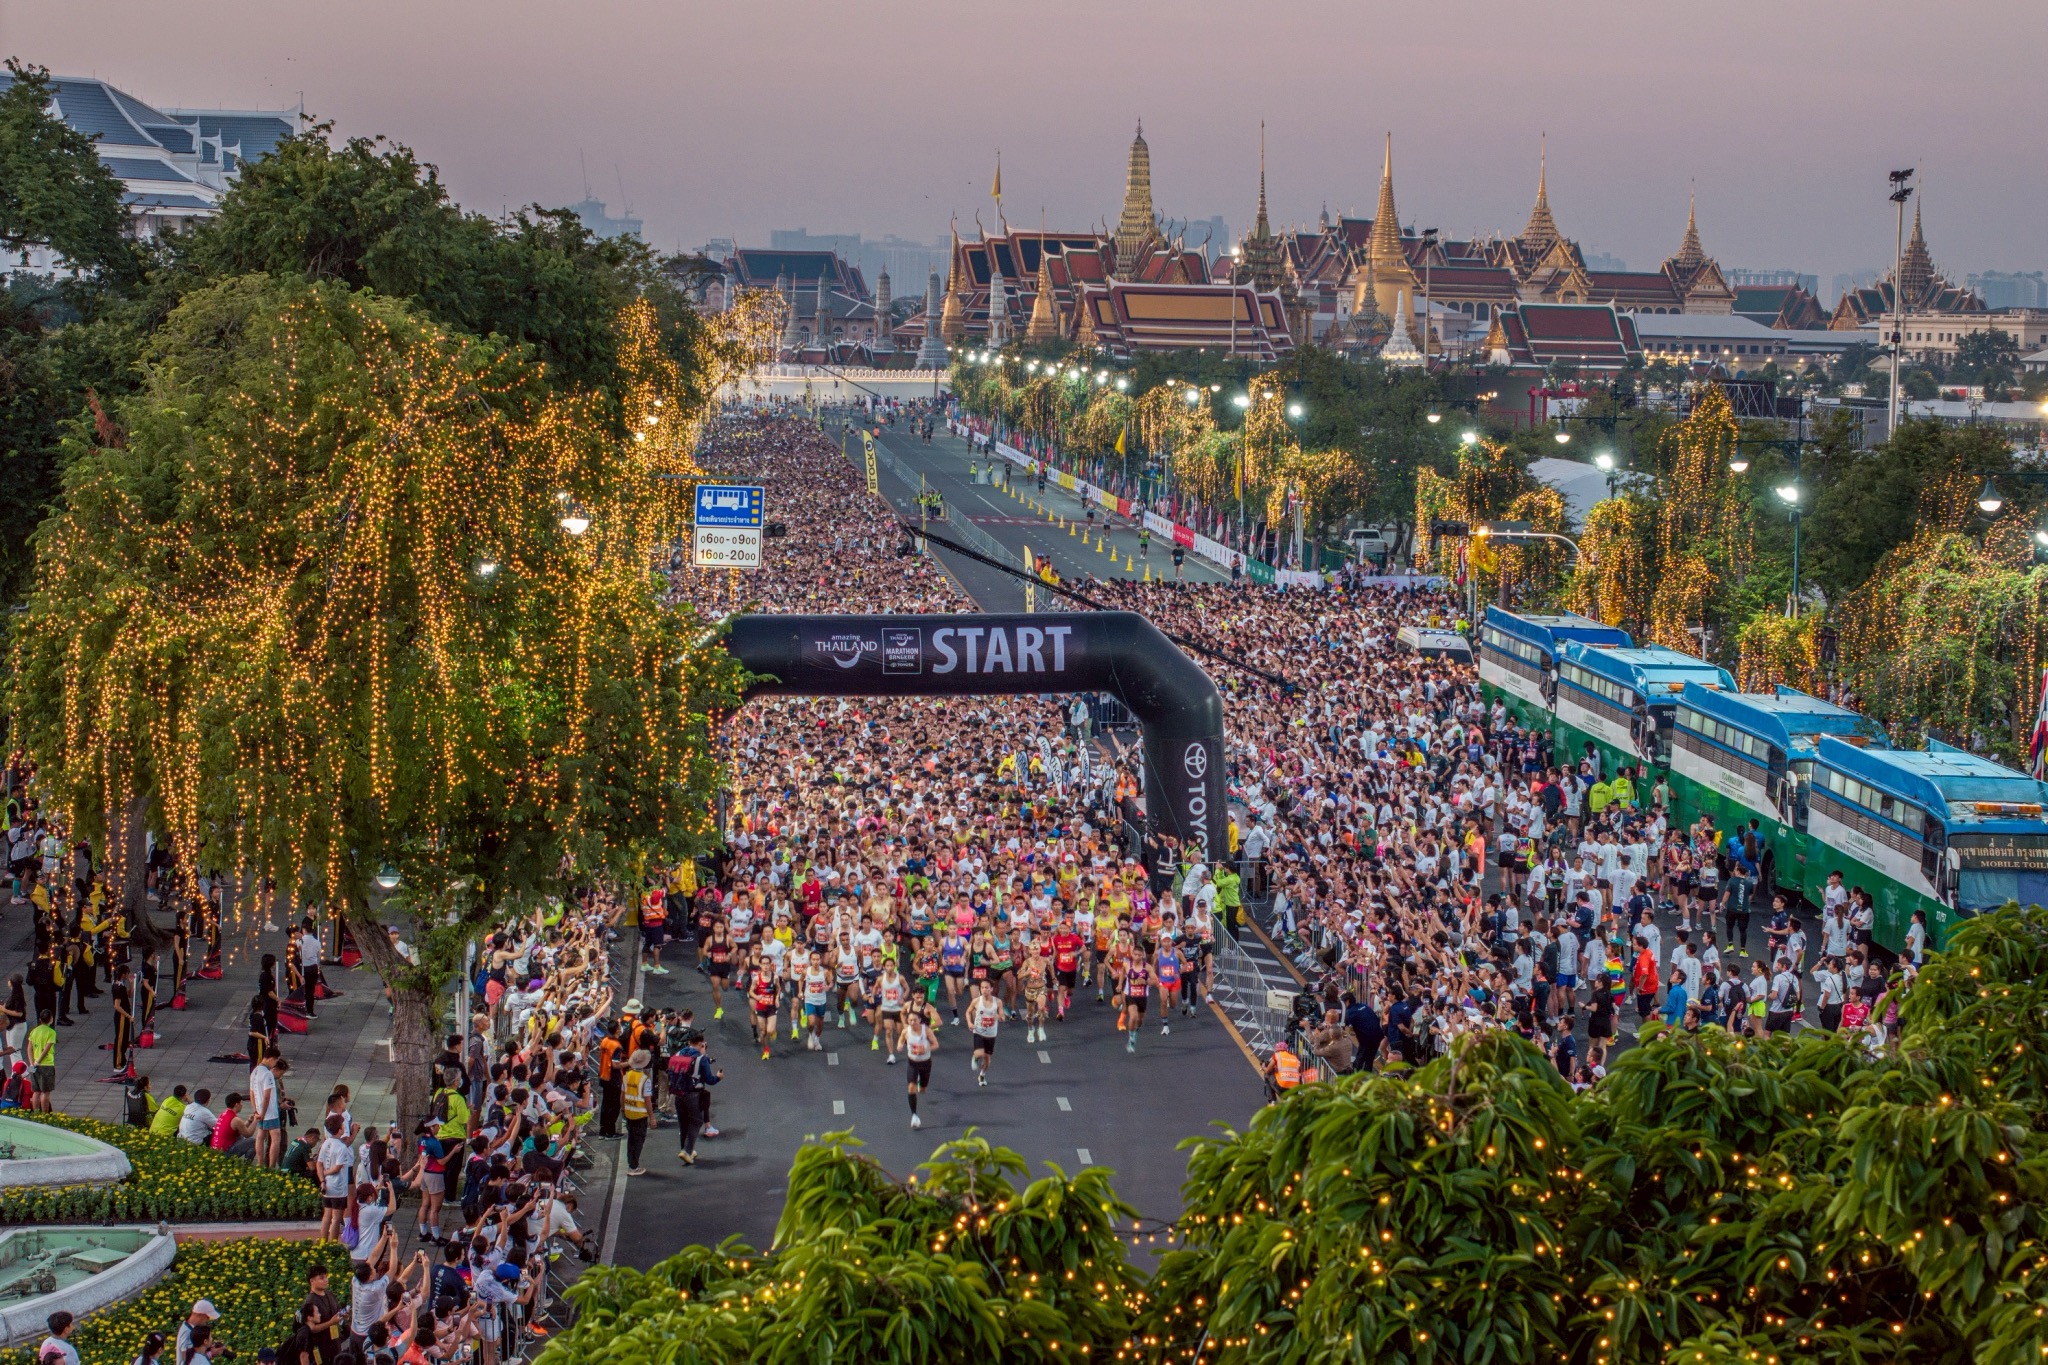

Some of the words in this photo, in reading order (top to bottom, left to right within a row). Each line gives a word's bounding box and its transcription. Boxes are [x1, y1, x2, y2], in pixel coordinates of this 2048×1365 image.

[815, 641, 878, 652] THAILAND
[933, 626, 1071, 674] START
[1188, 782, 1208, 863] TOYOT
[1955, 837, 2014, 860] ถสุขาเคลื่อนที่
[1981, 860, 2021, 868] MOBILE
